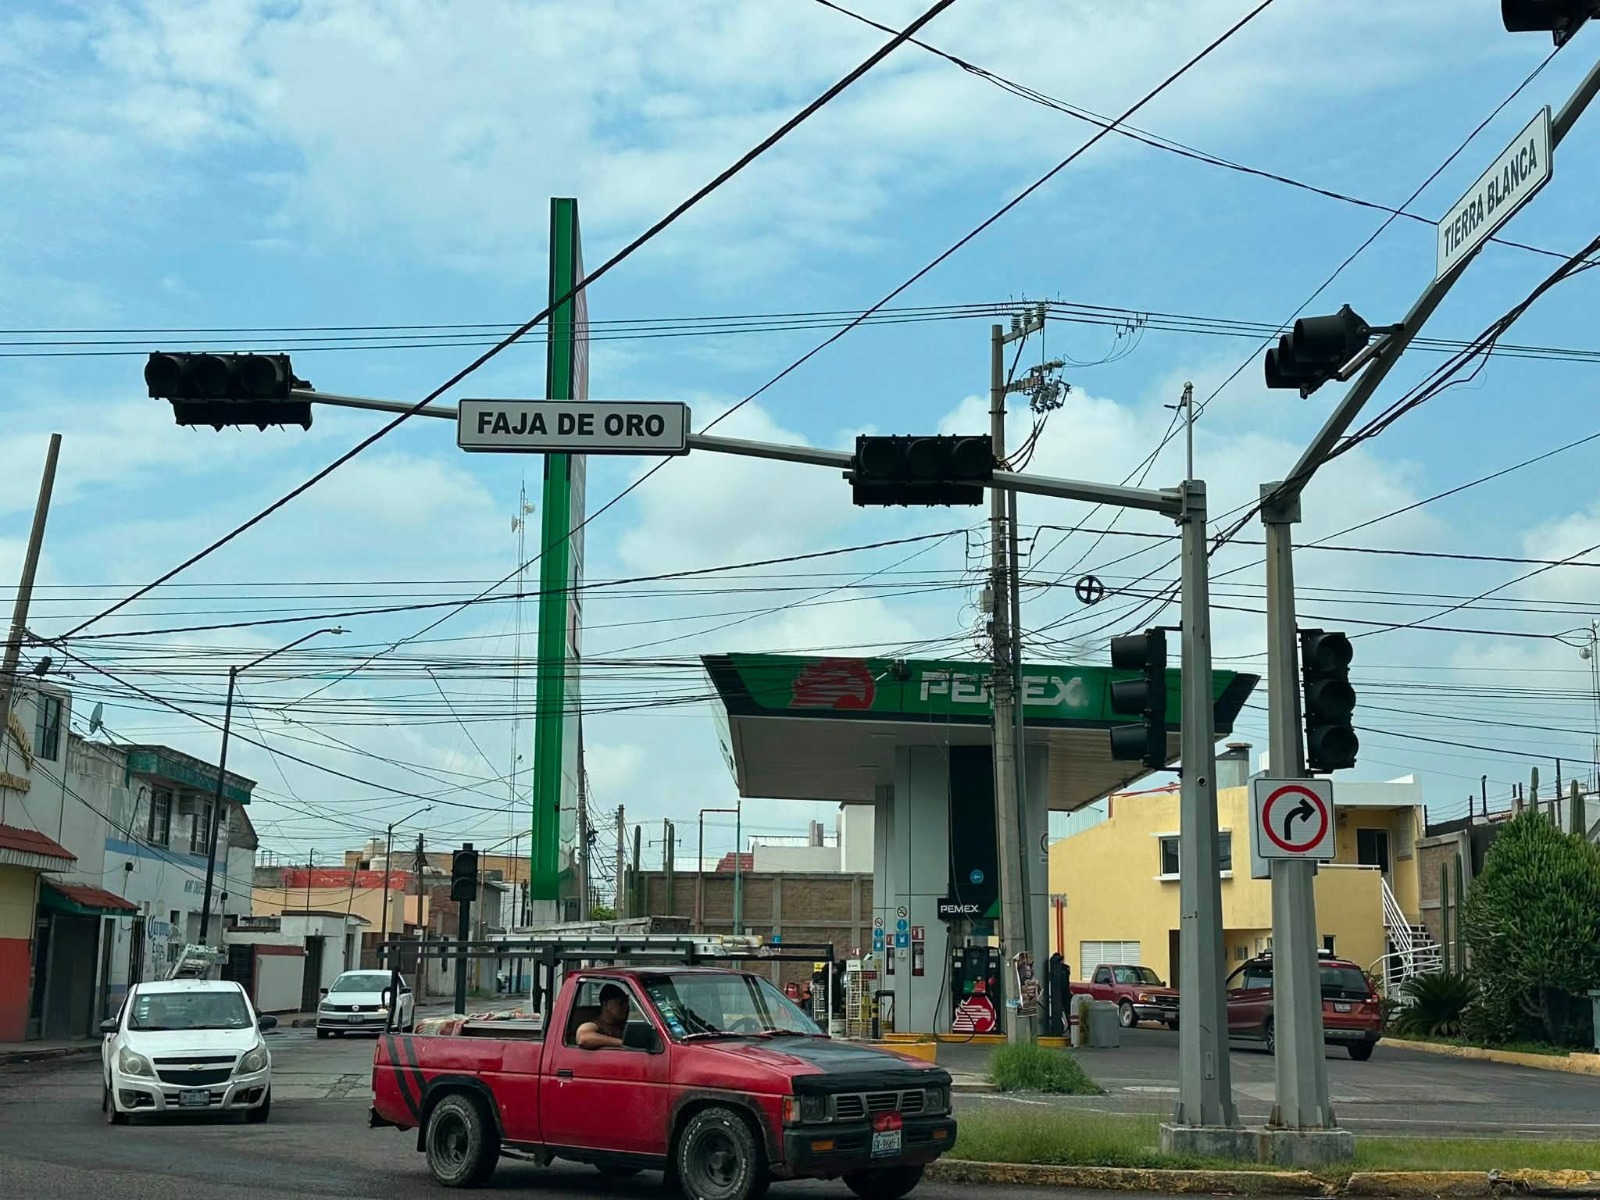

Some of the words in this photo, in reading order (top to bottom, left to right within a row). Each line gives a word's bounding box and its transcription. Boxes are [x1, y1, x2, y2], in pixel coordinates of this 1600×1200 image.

[1444, 192, 1485, 257] TIERRA
[1487, 137, 1538, 216] BLANCA
[477, 411, 548, 435] FAJA
[557, 412, 595, 436] DE
[604, 413, 665, 437] ORO
[940, 904, 979, 913] PEMEX
